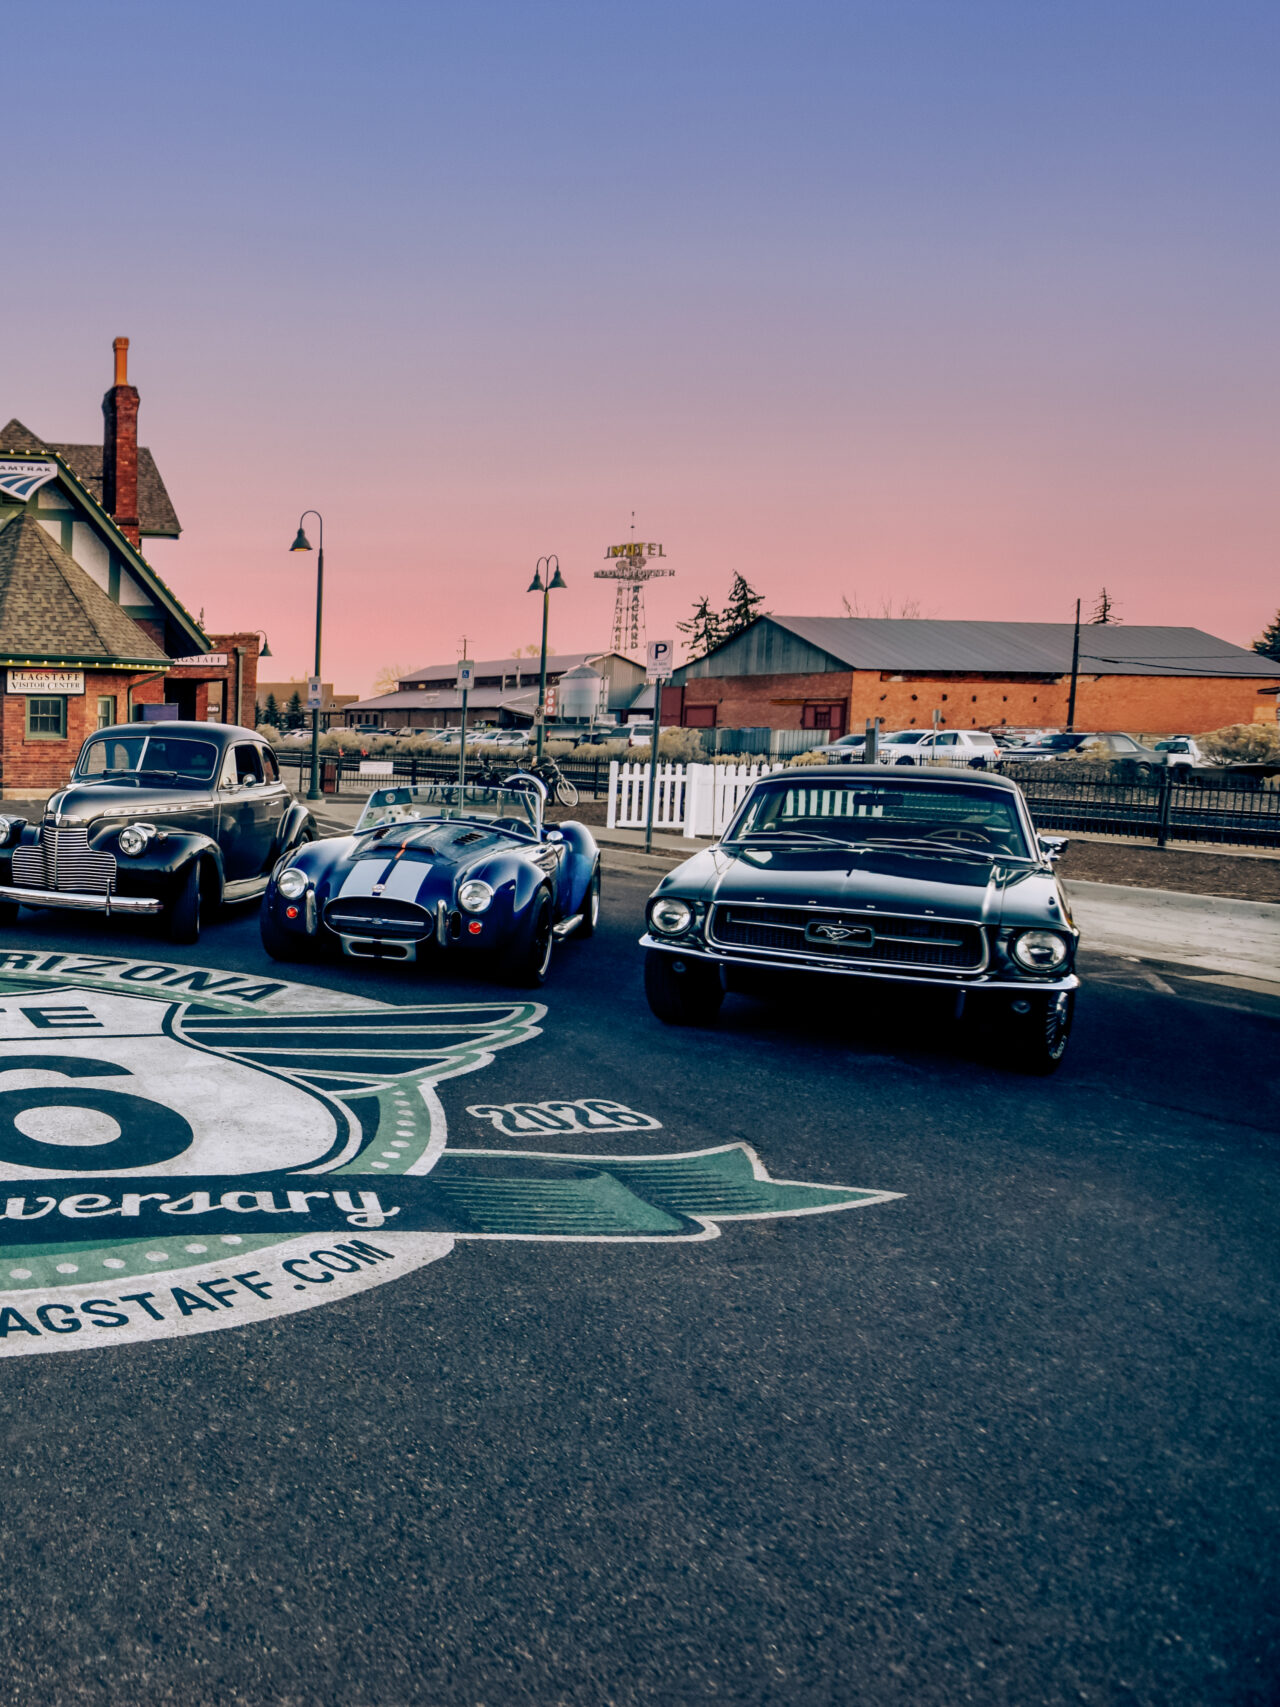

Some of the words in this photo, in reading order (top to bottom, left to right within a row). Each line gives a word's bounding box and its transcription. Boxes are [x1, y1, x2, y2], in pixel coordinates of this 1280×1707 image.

[0, 464, 52, 472] AMTRAK
[611, 542, 667, 558] MOTEL
[654, 643, 668, 659] P
[175, 656, 221, 664] AGSTAFF
[11, 671, 81, 681] FLAGSTAFF
[11, 681, 45, 690] VISITOR
[47, 681, 80, 691] CENTER
[473, 1101, 653, 1135] 2026
